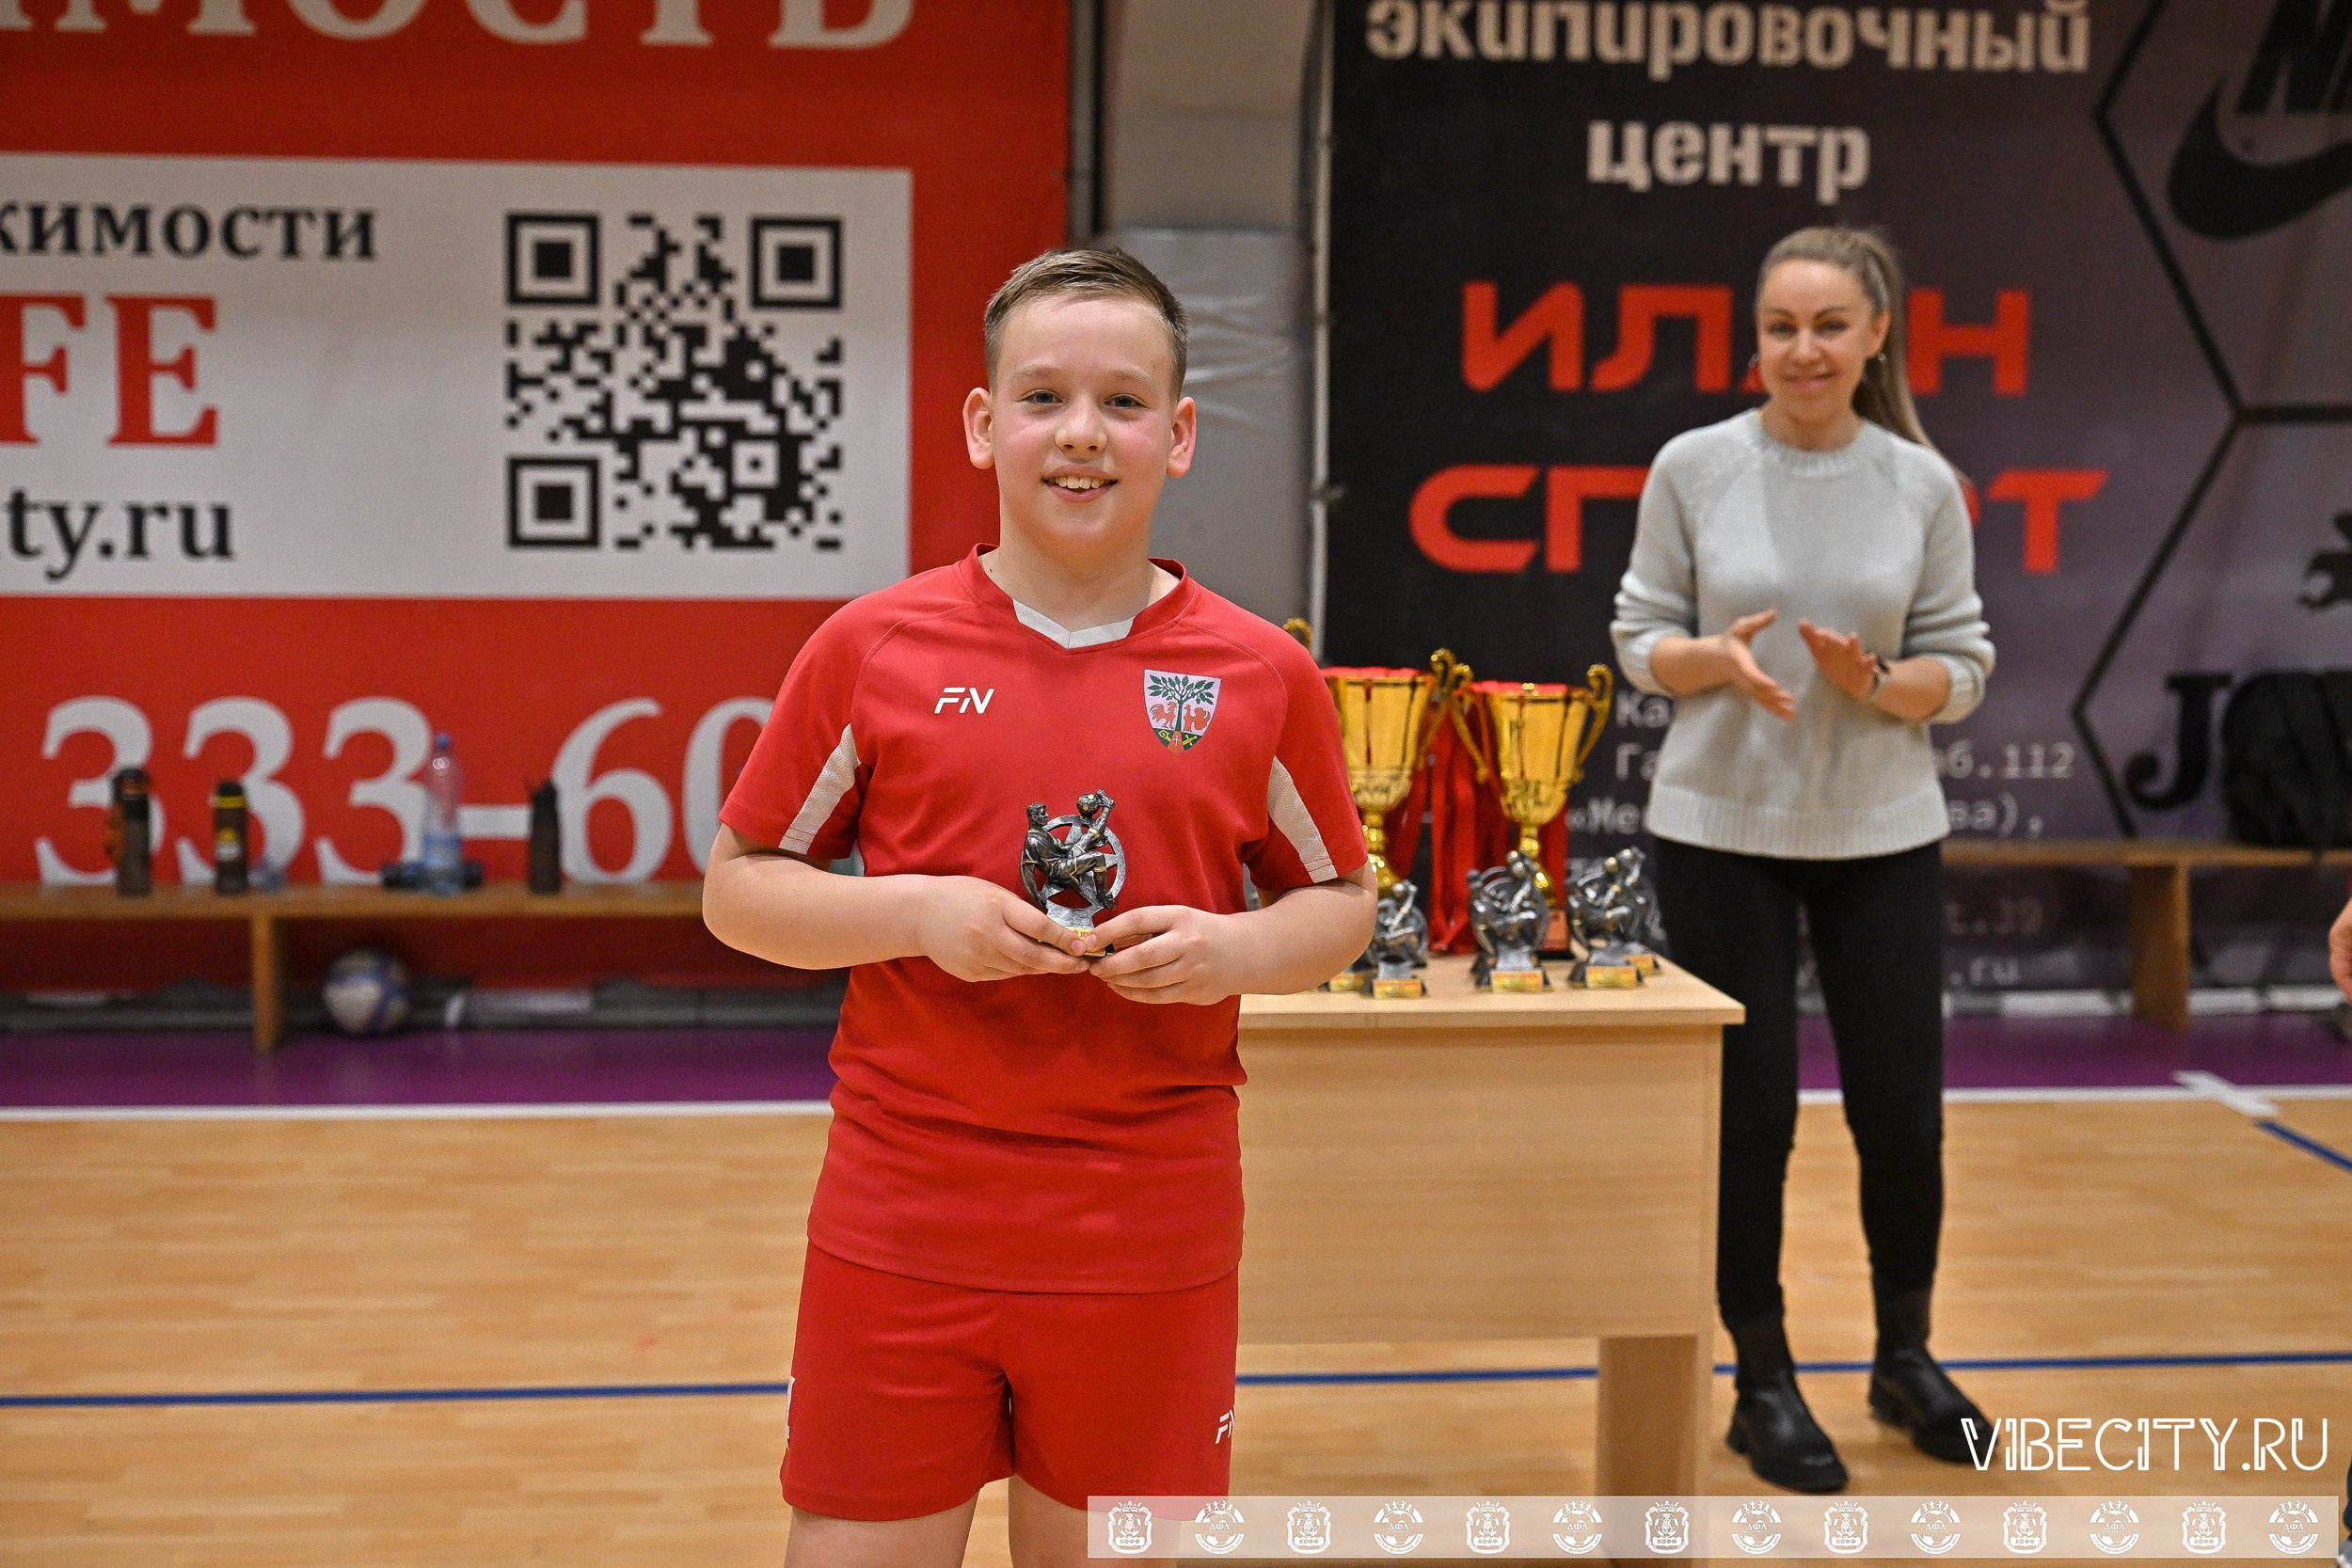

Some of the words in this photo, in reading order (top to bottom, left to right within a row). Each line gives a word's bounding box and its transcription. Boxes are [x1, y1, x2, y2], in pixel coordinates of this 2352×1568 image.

[1364, 0, 2090, 81] экипировочный
[1587, 119, 1872, 204] центр
[0, 293, 218, 446] FE
[1462, 280, 2031, 396] ИЛН
[7, 487, 237, 584] ty.ru
